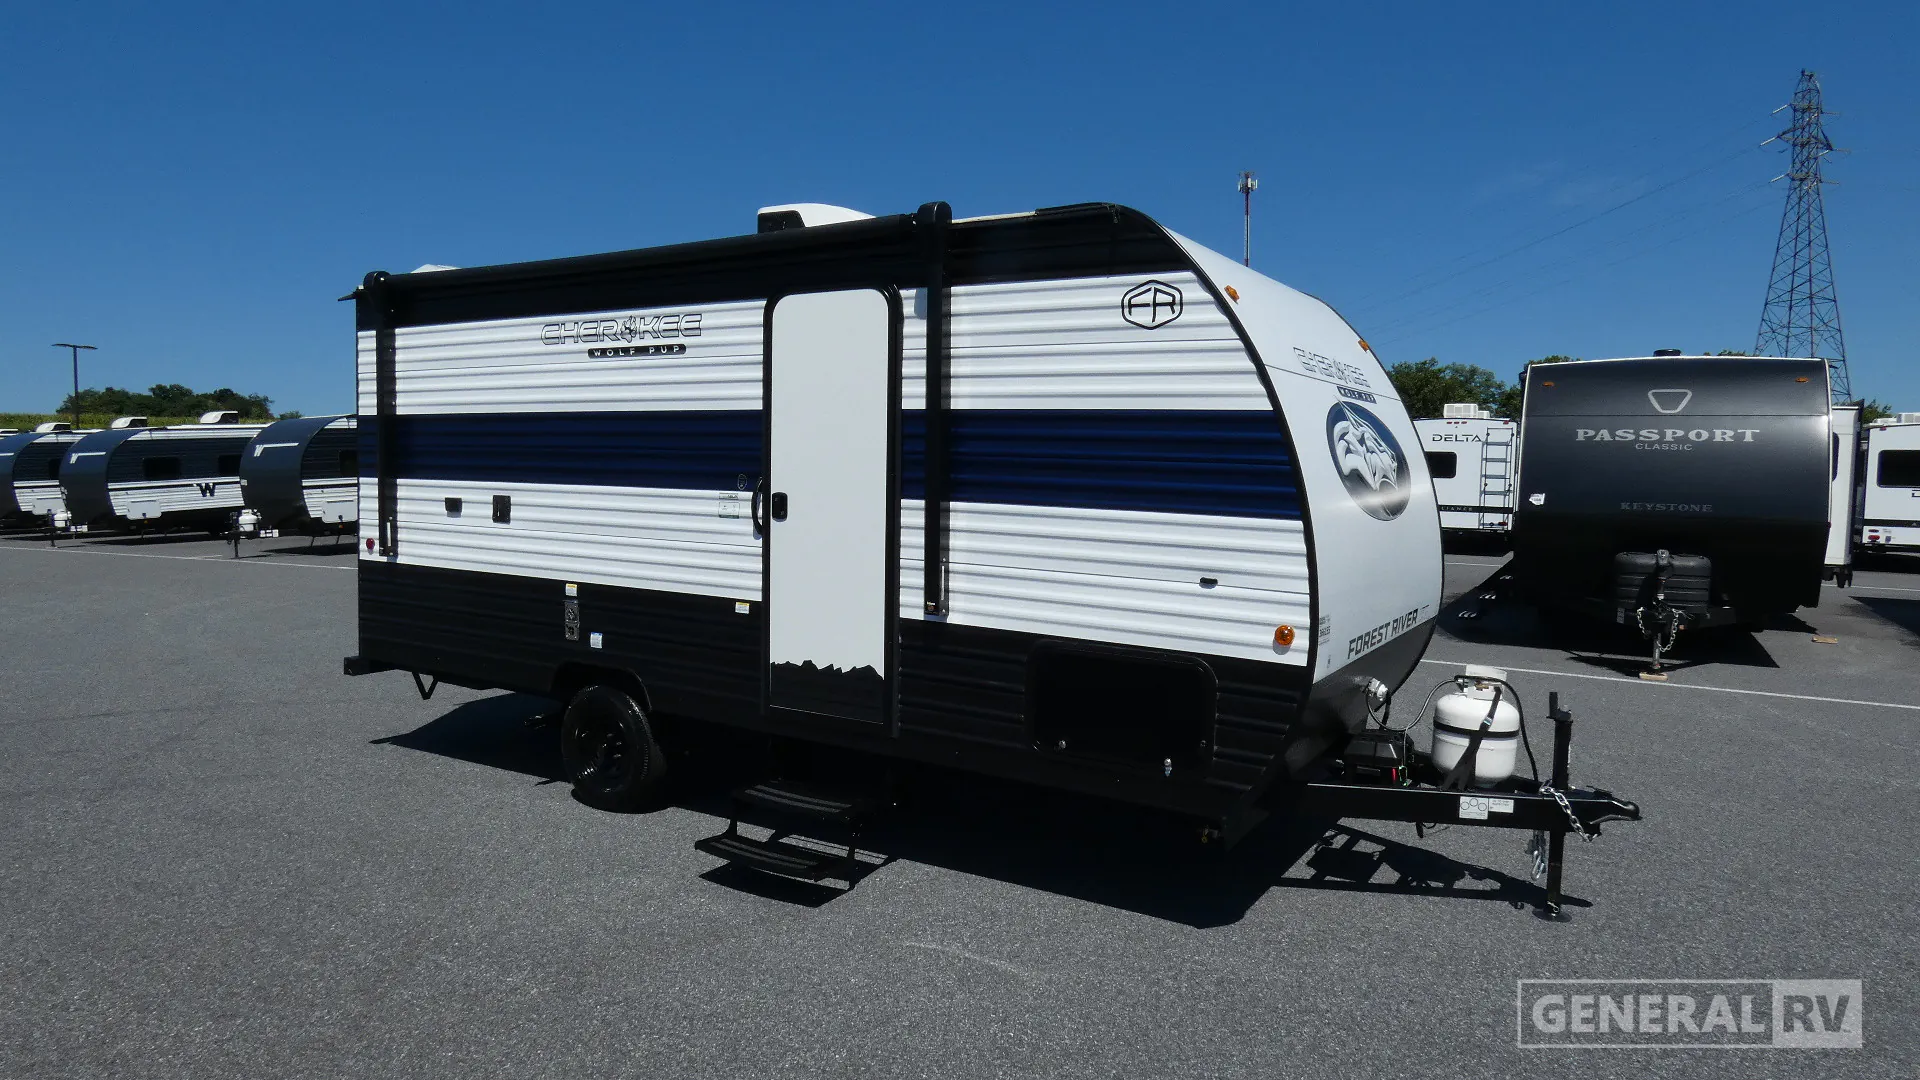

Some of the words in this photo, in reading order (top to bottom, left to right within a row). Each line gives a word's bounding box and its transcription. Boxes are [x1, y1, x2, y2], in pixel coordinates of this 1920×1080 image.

[541, 313, 702, 345] CHEROKEE
[593, 348, 635, 357] WOLF
[649, 345, 680, 354] PUP
[1432, 434, 1482, 442] DELTA
[1576, 429, 1760, 442] PASSPORT
[1635, 443, 1693, 451] CLASSIC
[1620, 502, 1713, 512] KEYSTONE
[1348, 621, 1391, 659] FOREST
[1391, 608, 1419, 637] RIVER
